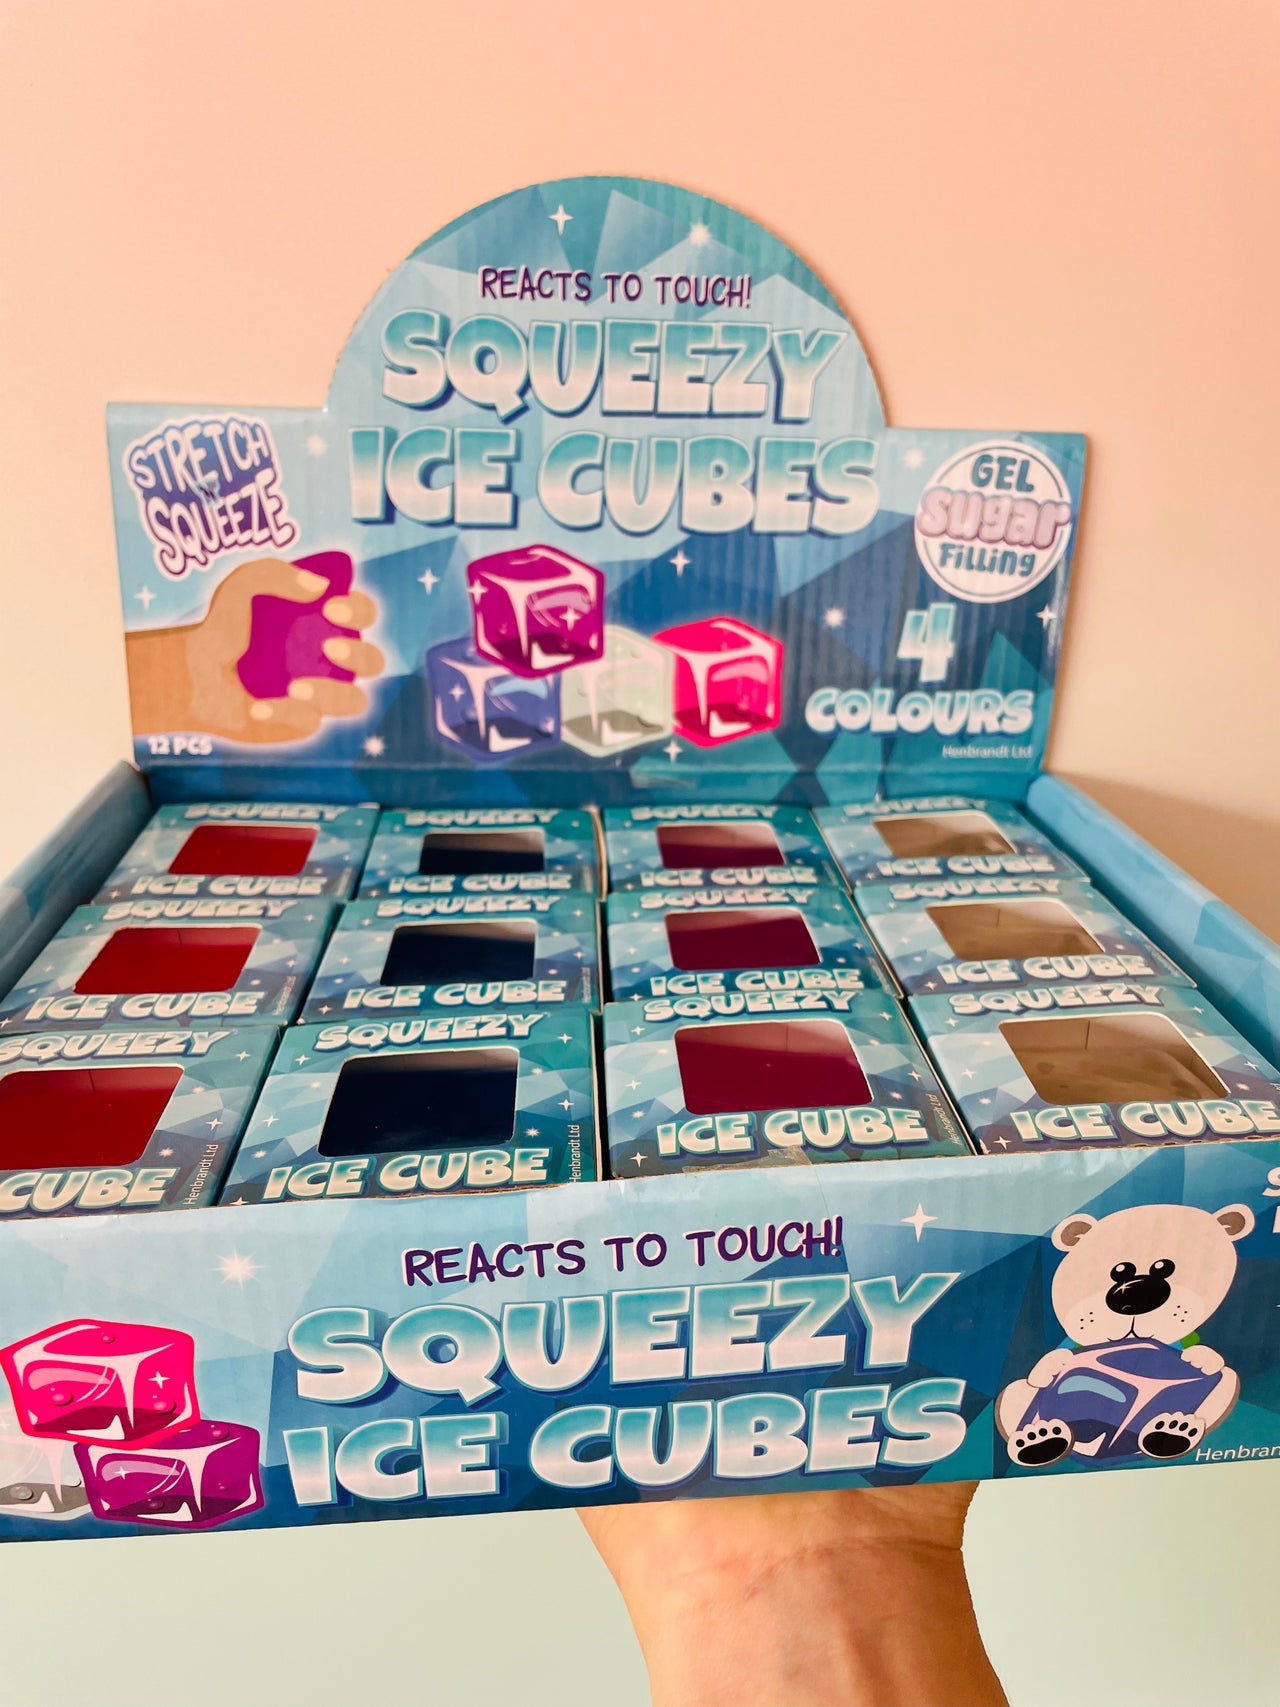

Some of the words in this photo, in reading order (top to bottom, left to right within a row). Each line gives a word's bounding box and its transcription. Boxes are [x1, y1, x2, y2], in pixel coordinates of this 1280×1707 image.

[480, 266, 592, 303] REACTS
[604, 271, 643, 304] TO
[655, 274, 752, 309] TOUCH!
[381, 307, 848, 425] SQUEEZY
[129, 418, 273, 494] STRETCH
[348, 426, 521, 529] ICE
[538, 431, 881, 537] CUBES
[971, 454, 1035, 493] GEL
[146, 467, 295, 575] SQUEEZE
[896, 602, 958, 686] 4
[804, 686, 1035, 737] COLOURS
[148, 735, 170, 755] 12
[173, 735, 213, 756] PCS
[184, 803, 347, 821] SQUEEZY
[404, 808, 559, 827] SQUEEZY
[630, 804, 778, 820] SQUEEZY
[639, 868, 704, 887] ICE
[710, 866, 818, 885] CUBE
[876, 858, 943, 876] ICE
[947, 854, 1056, 875] CUBE
[130, 874, 206, 896] ICE
[208, 874, 328, 897] CUBE
[388, 874, 456, 894] ICE
[461, 873, 573, 893] CUBE
[640, 888, 814, 909] SQUEEZY
[889, 878, 1061, 901] SQUEEZY
[102, 899, 297, 921] SQUEEZY
[377, 896, 561, 917] SQUEEZY
[650, 973, 726, 997] ICE
[735, 968, 865, 992] CUBE
[937, 959, 1021, 985] ICE
[1023, 954, 1155, 980] CUBE
[24, 994, 119, 1021] ICE
[119, 991, 266, 1020] CUBE
[343, 984, 426, 1010] ICE
[433, 980, 567, 1007] CUBE
[644, 990, 858, 1023] SQUEEZY
[950, 983, 1165, 1015] SQUEEZY
[0, 1030, 231, 1064] SQUEEZY
[312, 1013, 546, 1052] SQUEEZY
[567, 1124, 580, 1138] Ltd
[656, 1113, 757, 1160] ICE
[763, 1106, 931, 1149] CUBE
[933, 1106, 963, 1146] Henbrandt
[1009, 1103, 1119, 1142] ICE
[1120, 1099, 1280, 1138] CUBE
[0, 1166, 182, 1214] CUBE
[182, 1158, 213, 1205] Henbrandt
[202, 1144, 219, 1157] Ltd
[262, 1157, 374, 1201] ICE
[379, 1147, 551, 1192] CUBE
[403, 1240, 584, 1288] REACTS
[605, 1233, 668, 1270] TO
[686, 1216, 843, 1265] TOUCH!
[286, 1272, 961, 1409] SQUEEZY
[283, 1412, 511, 1508] ICE
[528, 1377, 967, 1491] CUBES
